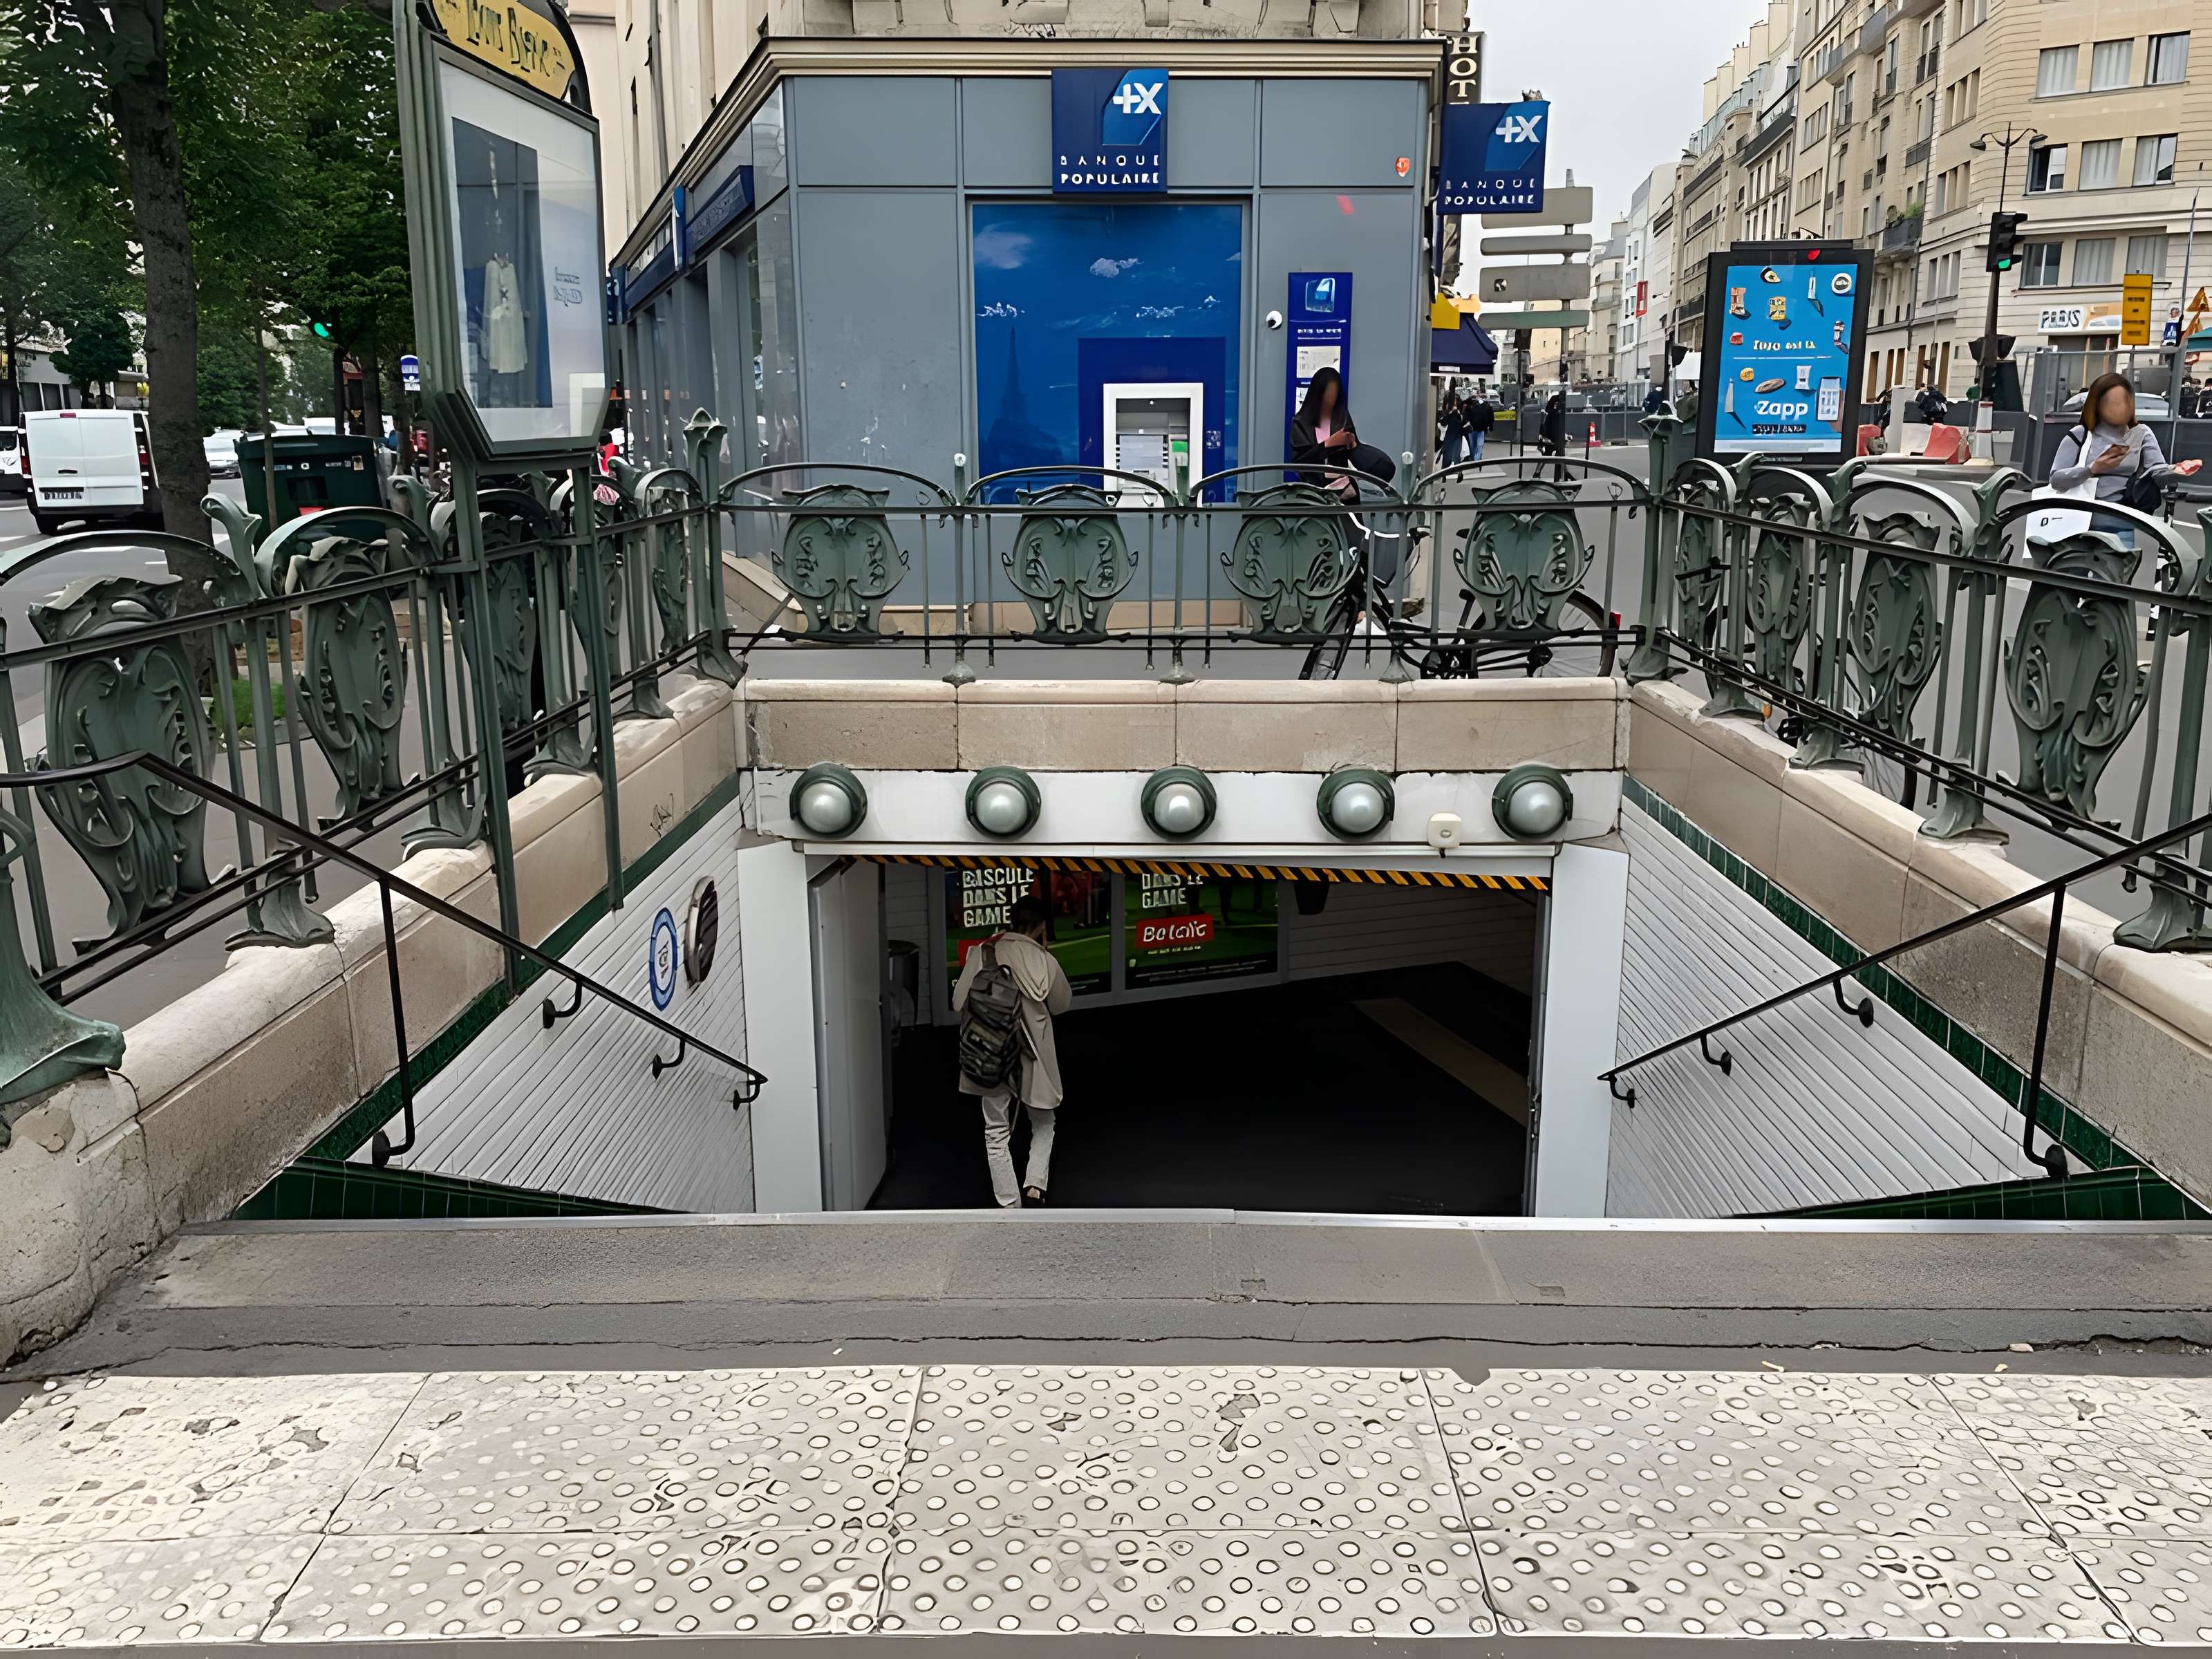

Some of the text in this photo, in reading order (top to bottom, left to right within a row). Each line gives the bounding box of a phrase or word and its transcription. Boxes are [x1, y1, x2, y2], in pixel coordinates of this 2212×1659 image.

[1449, 35, 1478, 104] HOT
[1060, 154, 1159, 166] BANQUE
[1060, 172, 1159, 185] POPULAIRE
[1444, 194, 1535, 205] POPULAIRE
[1754, 400, 1808, 420] Zapp
[1142, 888, 1188, 909] GAME
